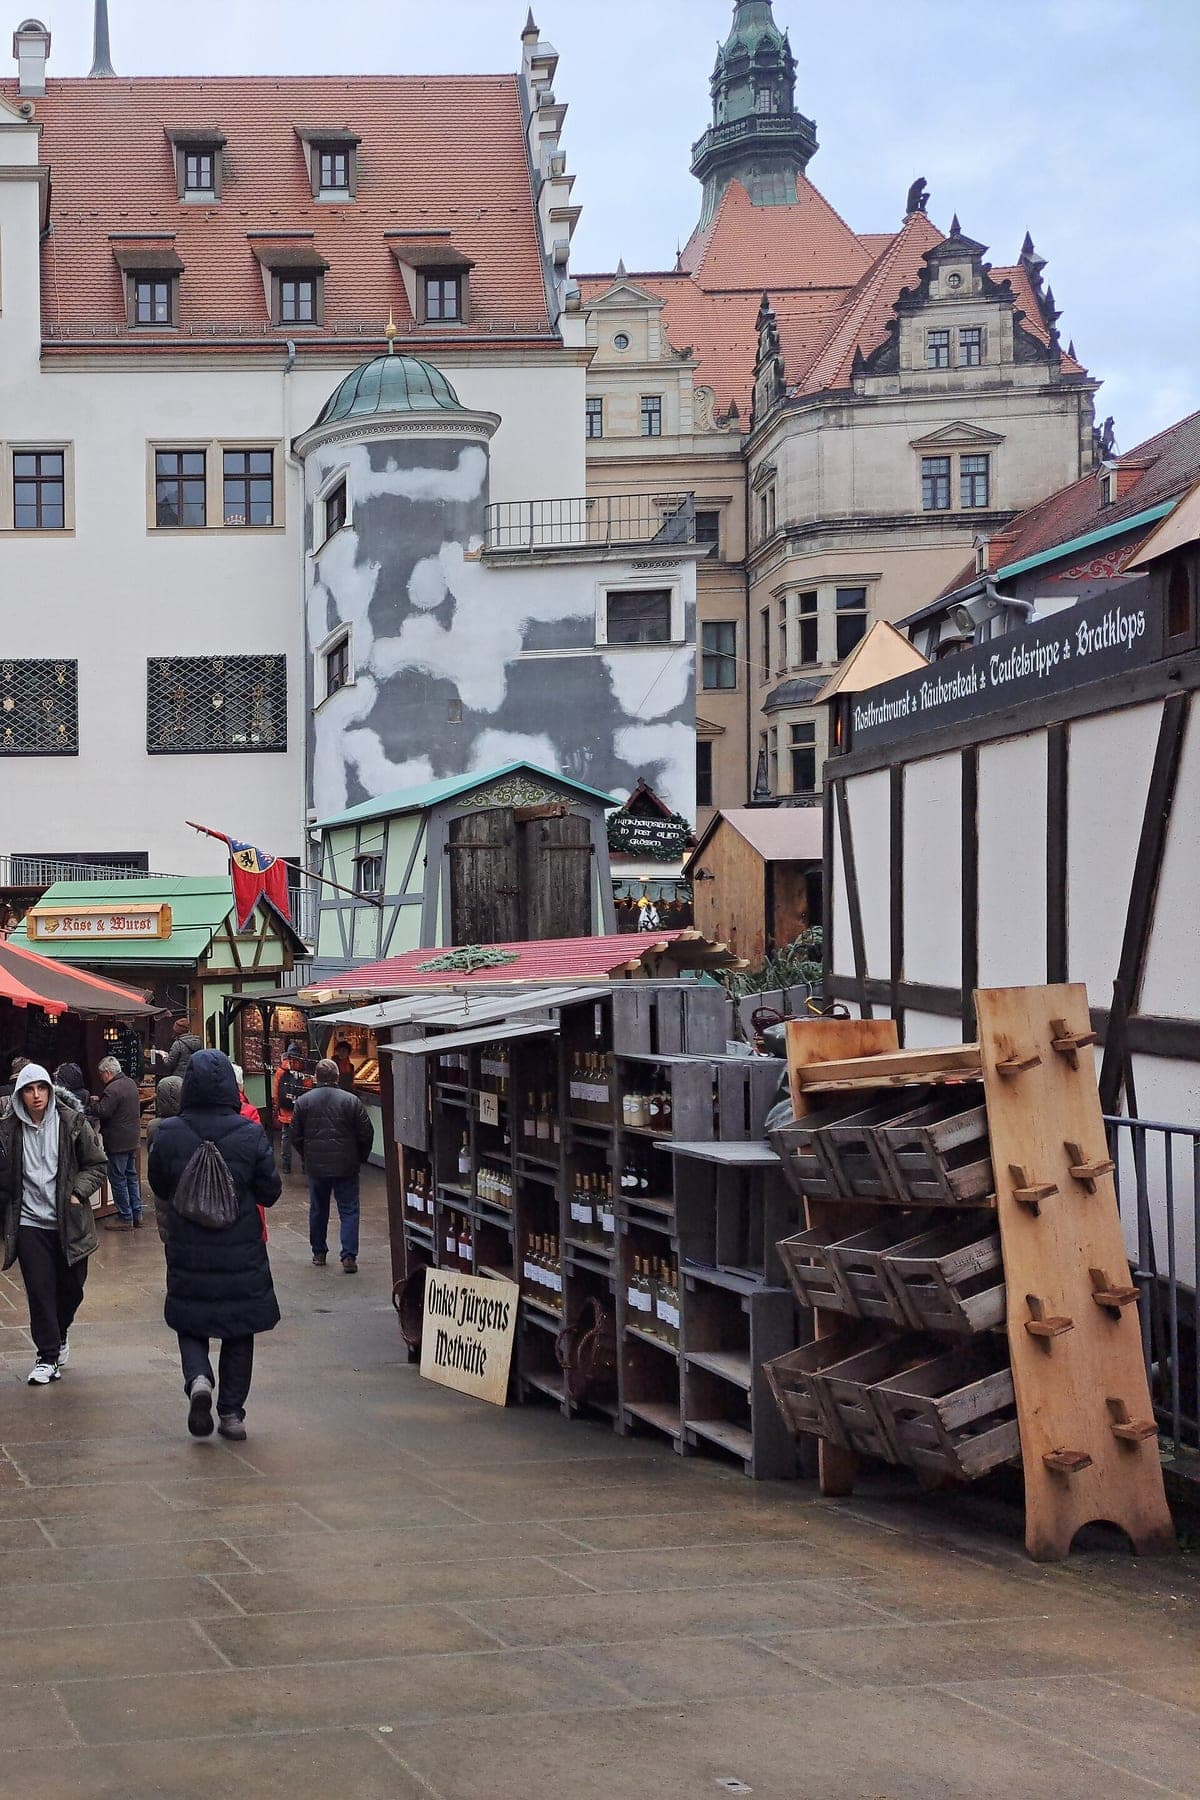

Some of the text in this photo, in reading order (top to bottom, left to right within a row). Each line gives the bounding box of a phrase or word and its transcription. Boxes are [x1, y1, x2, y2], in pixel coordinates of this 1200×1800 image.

[853, 606, 1146, 732] Rostbratwurst Räubersteak Teufelsrippe Bratklops
[62, 916, 151, 932] Käse & Wurst
[428, 1279, 510, 1333] Onkel Jürgens
[434, 1328, 487, 1377] Methütte
